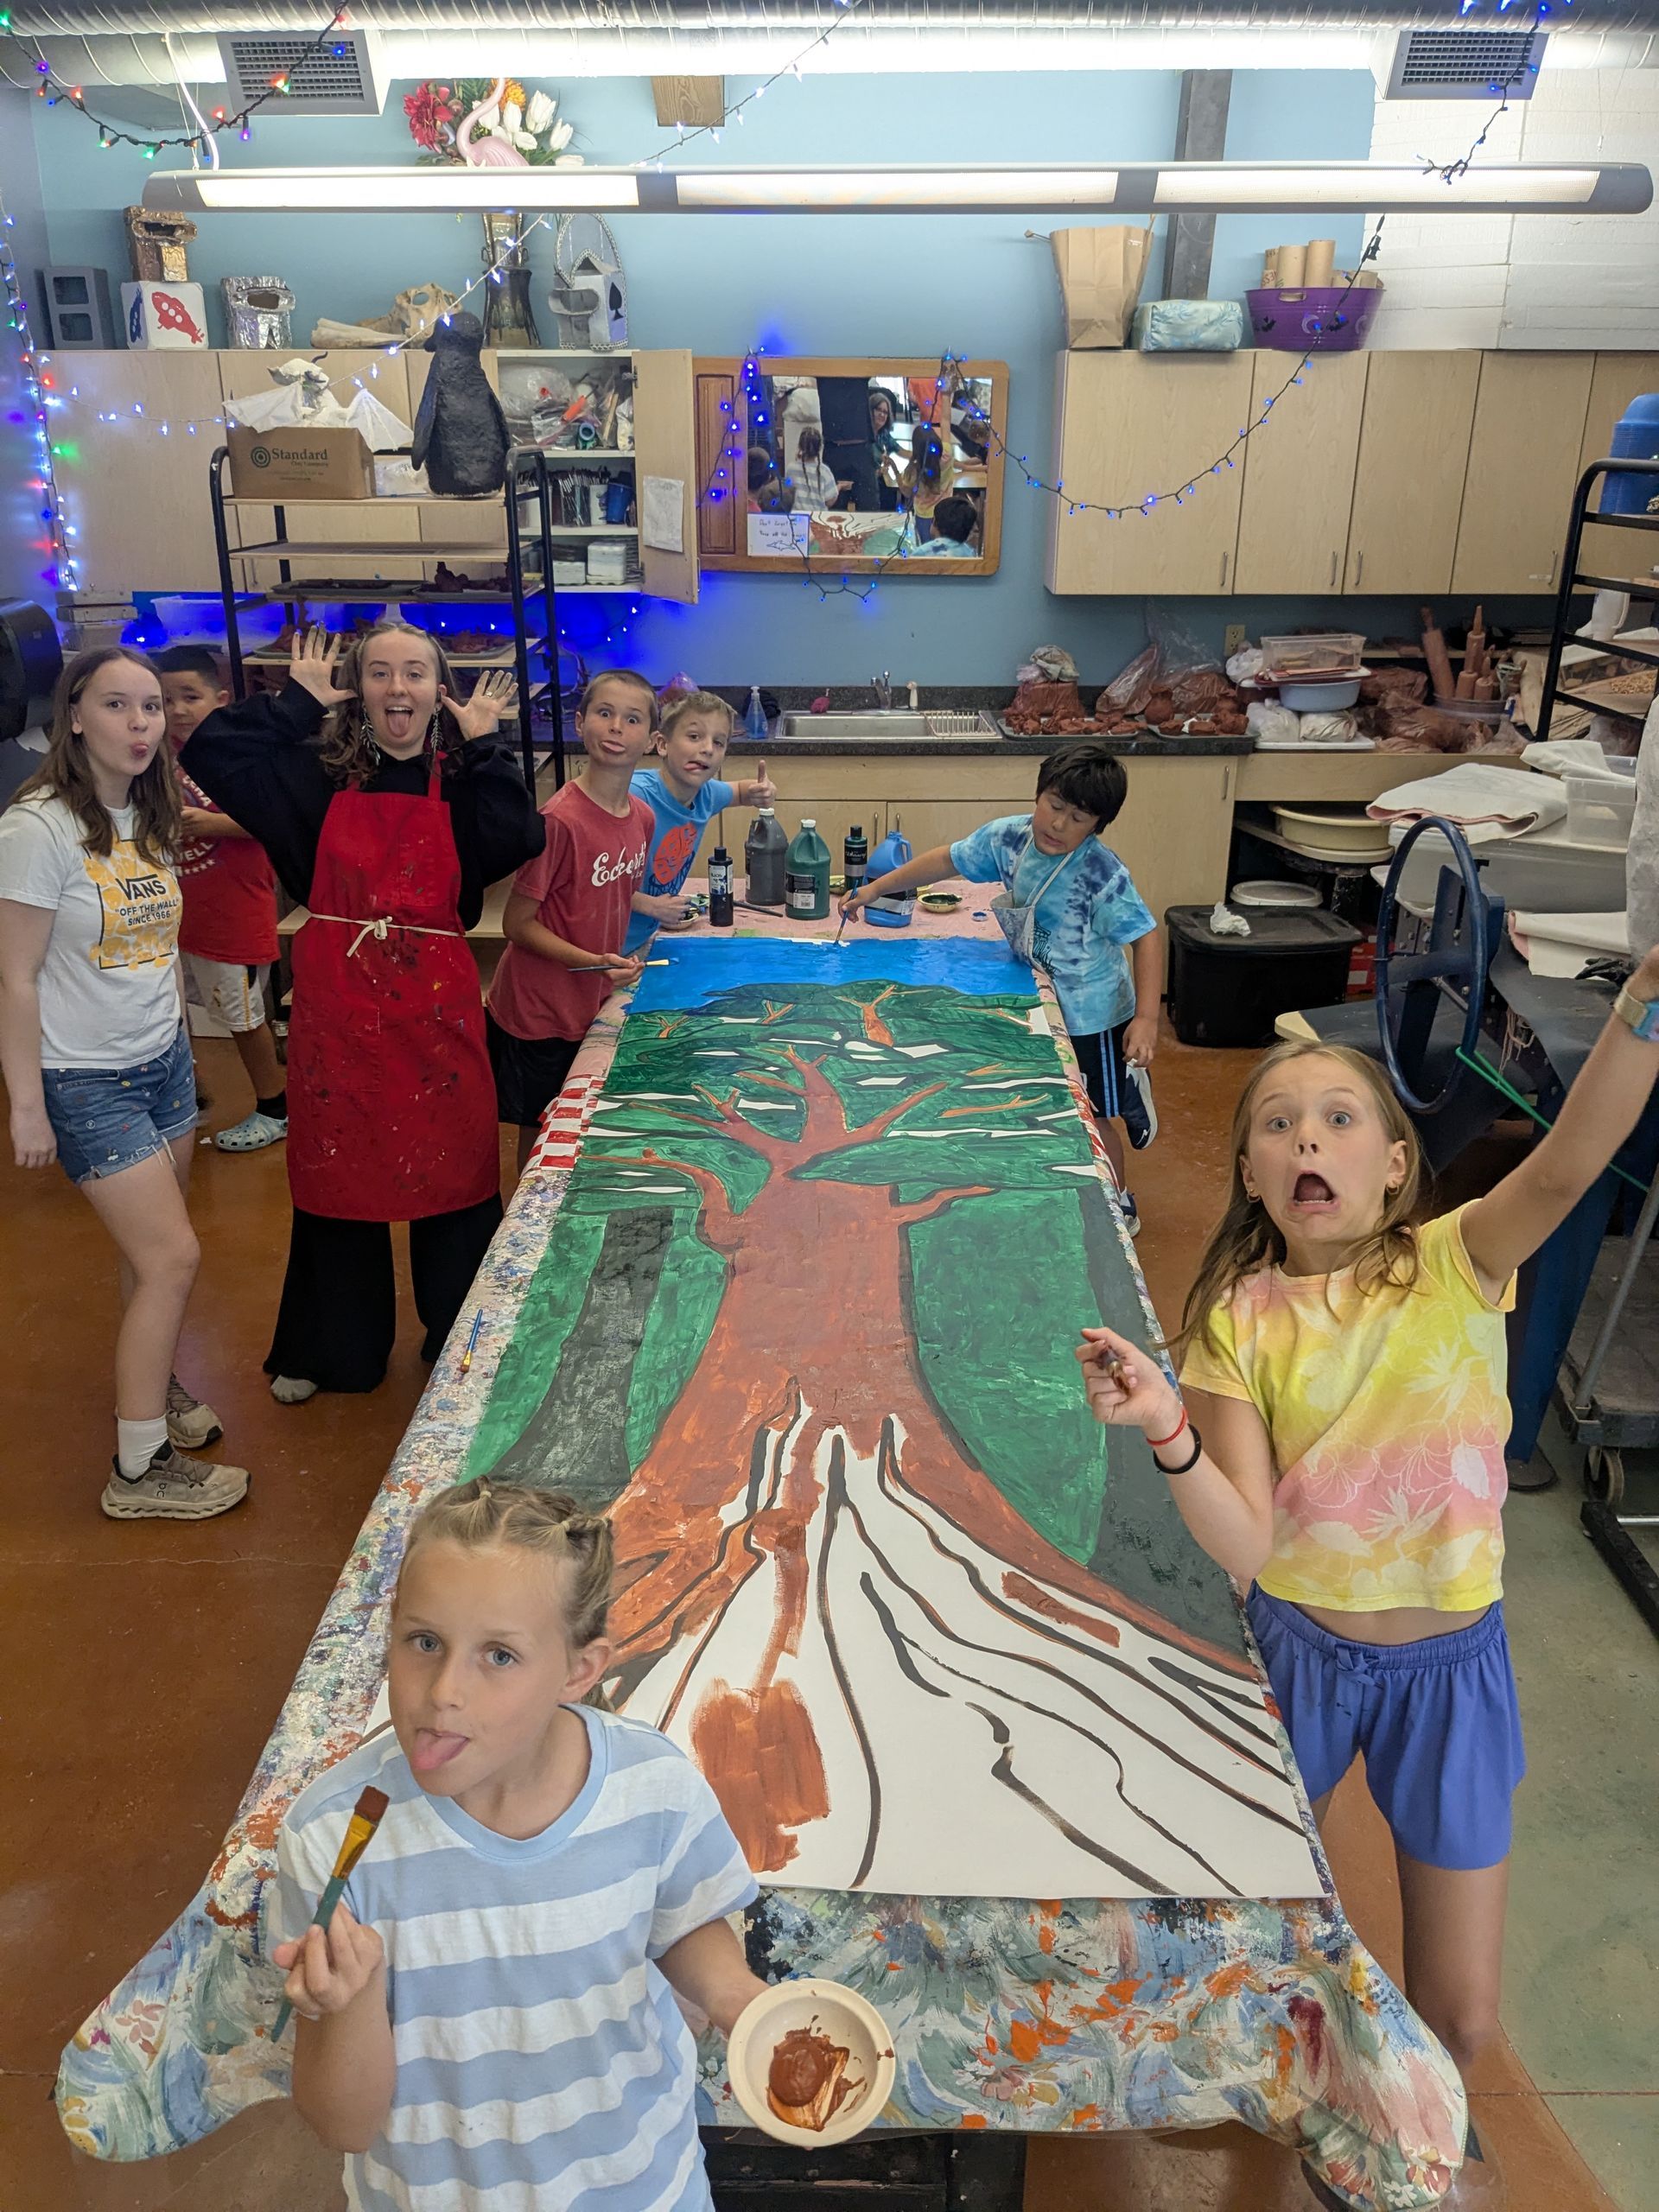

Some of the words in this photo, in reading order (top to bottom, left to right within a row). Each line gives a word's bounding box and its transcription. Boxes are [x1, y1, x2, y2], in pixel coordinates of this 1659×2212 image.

[272, 448, 328, 461] Standard
[115, 874, 167, 900] VANS
[139, 904, 156, 914] THE
[128, 913, 151, 926] SINCE
[153, 910, 171, 920] 1966
